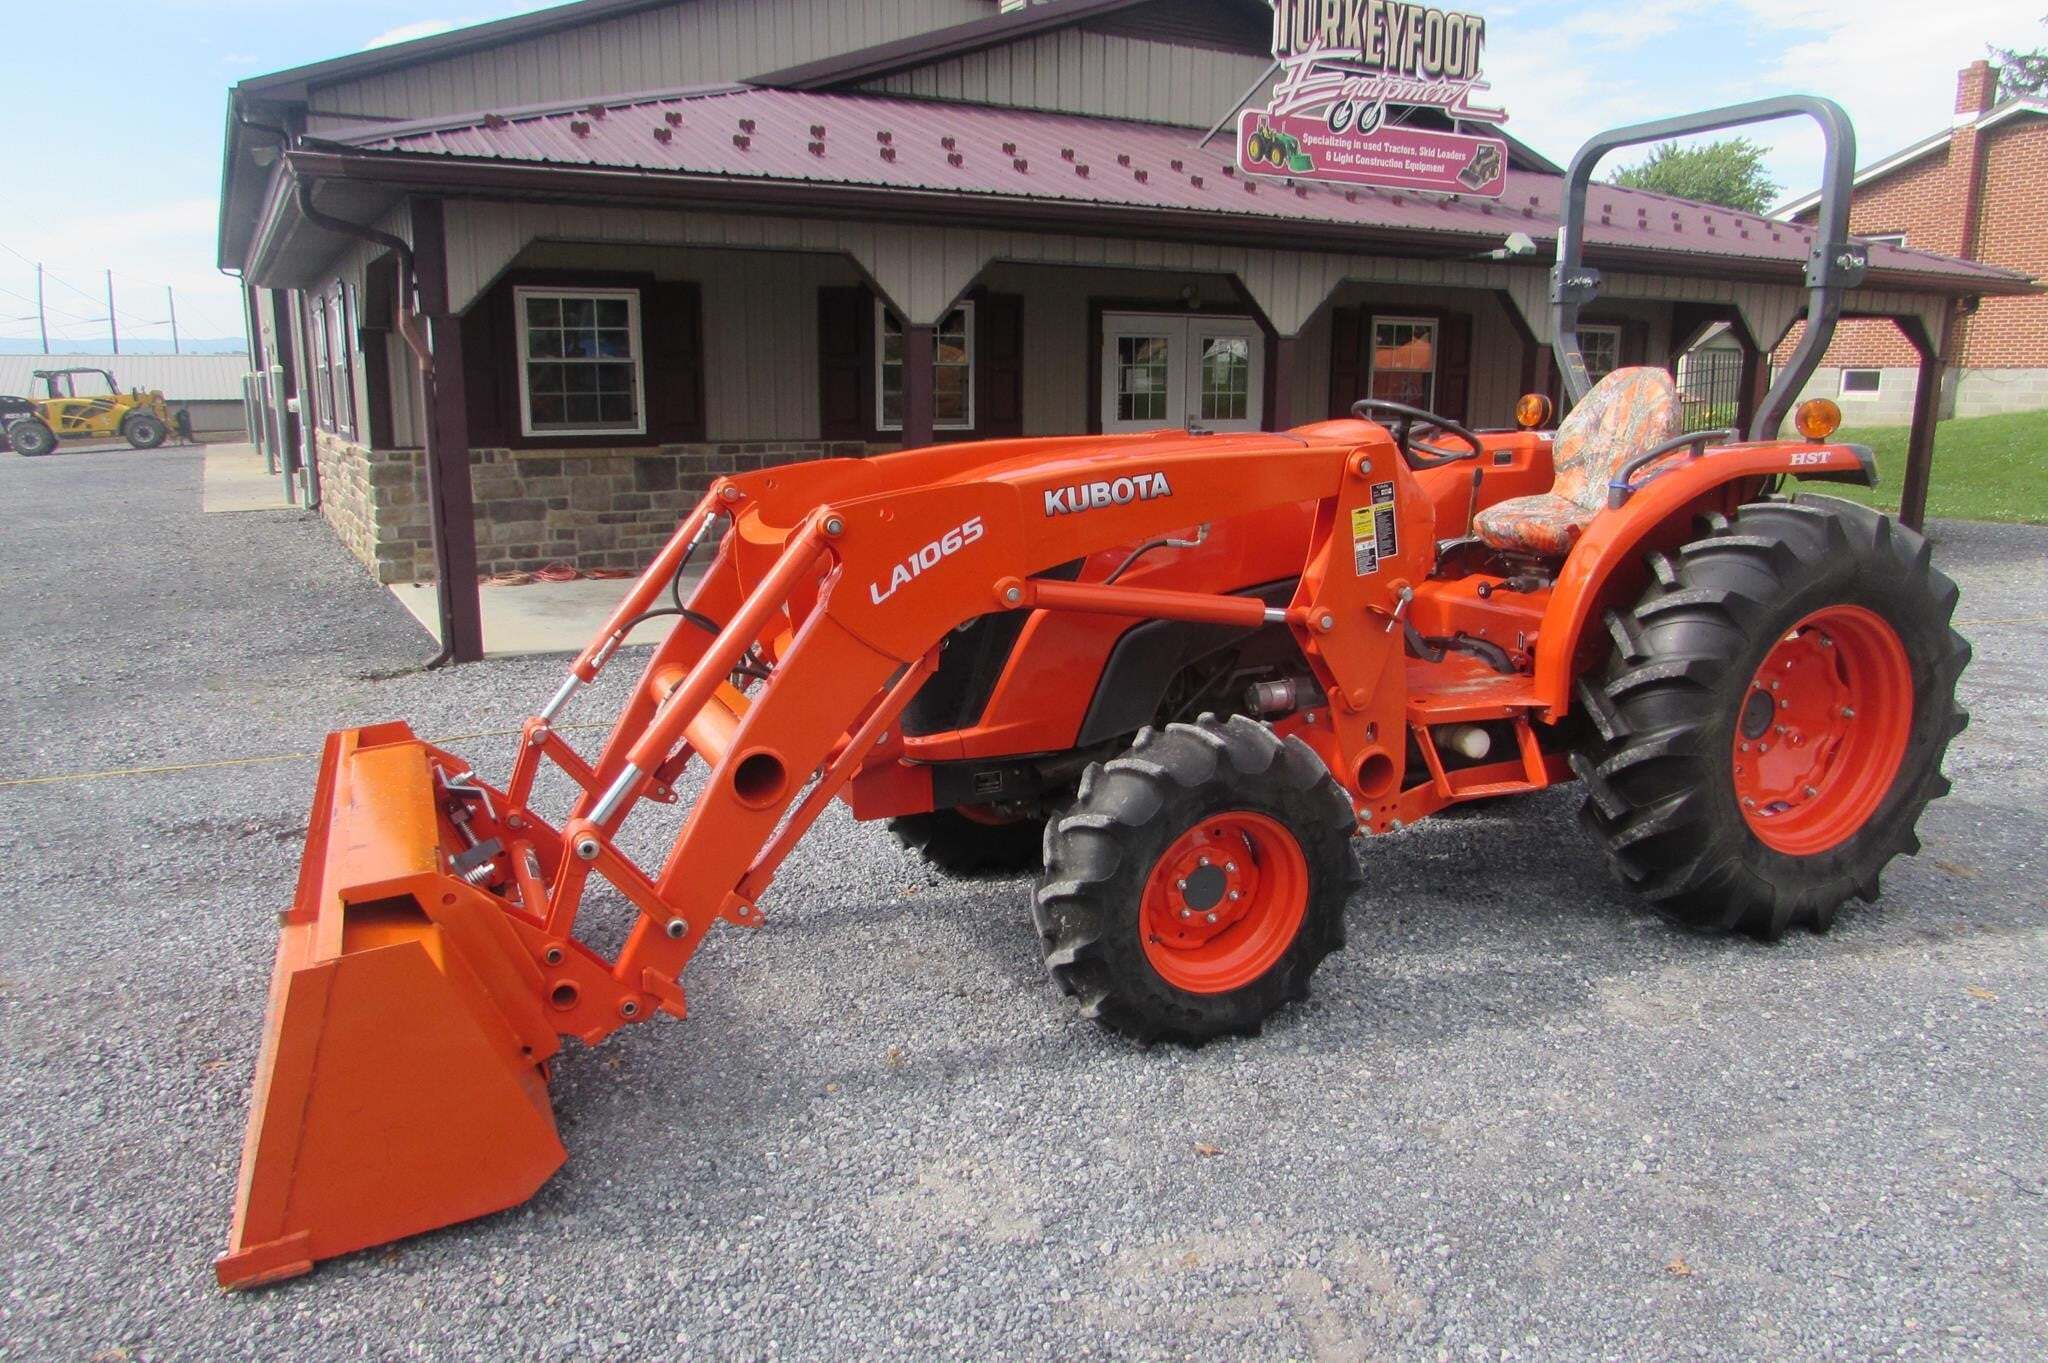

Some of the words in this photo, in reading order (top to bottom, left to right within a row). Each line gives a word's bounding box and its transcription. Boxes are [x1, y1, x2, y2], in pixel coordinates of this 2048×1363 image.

[1274, 0, 1484, 79] TURKEYFOOT
[1270, 36, 1508, 119] Equipment
[1302, 132, 1352, 150] Specializing
[1353, 139, 1361, 149] in
[1363, 141, 1382, 152] used
[1419, 146, 1436, 157] Skid
[1437, 148, 1467, 161] Loaders
[1333, 151, 1354, 165] Light
[1355, 154, 1403, 169] Construction
[1404, 159, 1445, 174] Equipment
[1789, 451, 1831, 466] HST
[1044, 472, 1173, 517] KUBOTA
[870, 516, 984, 605] LA1065
